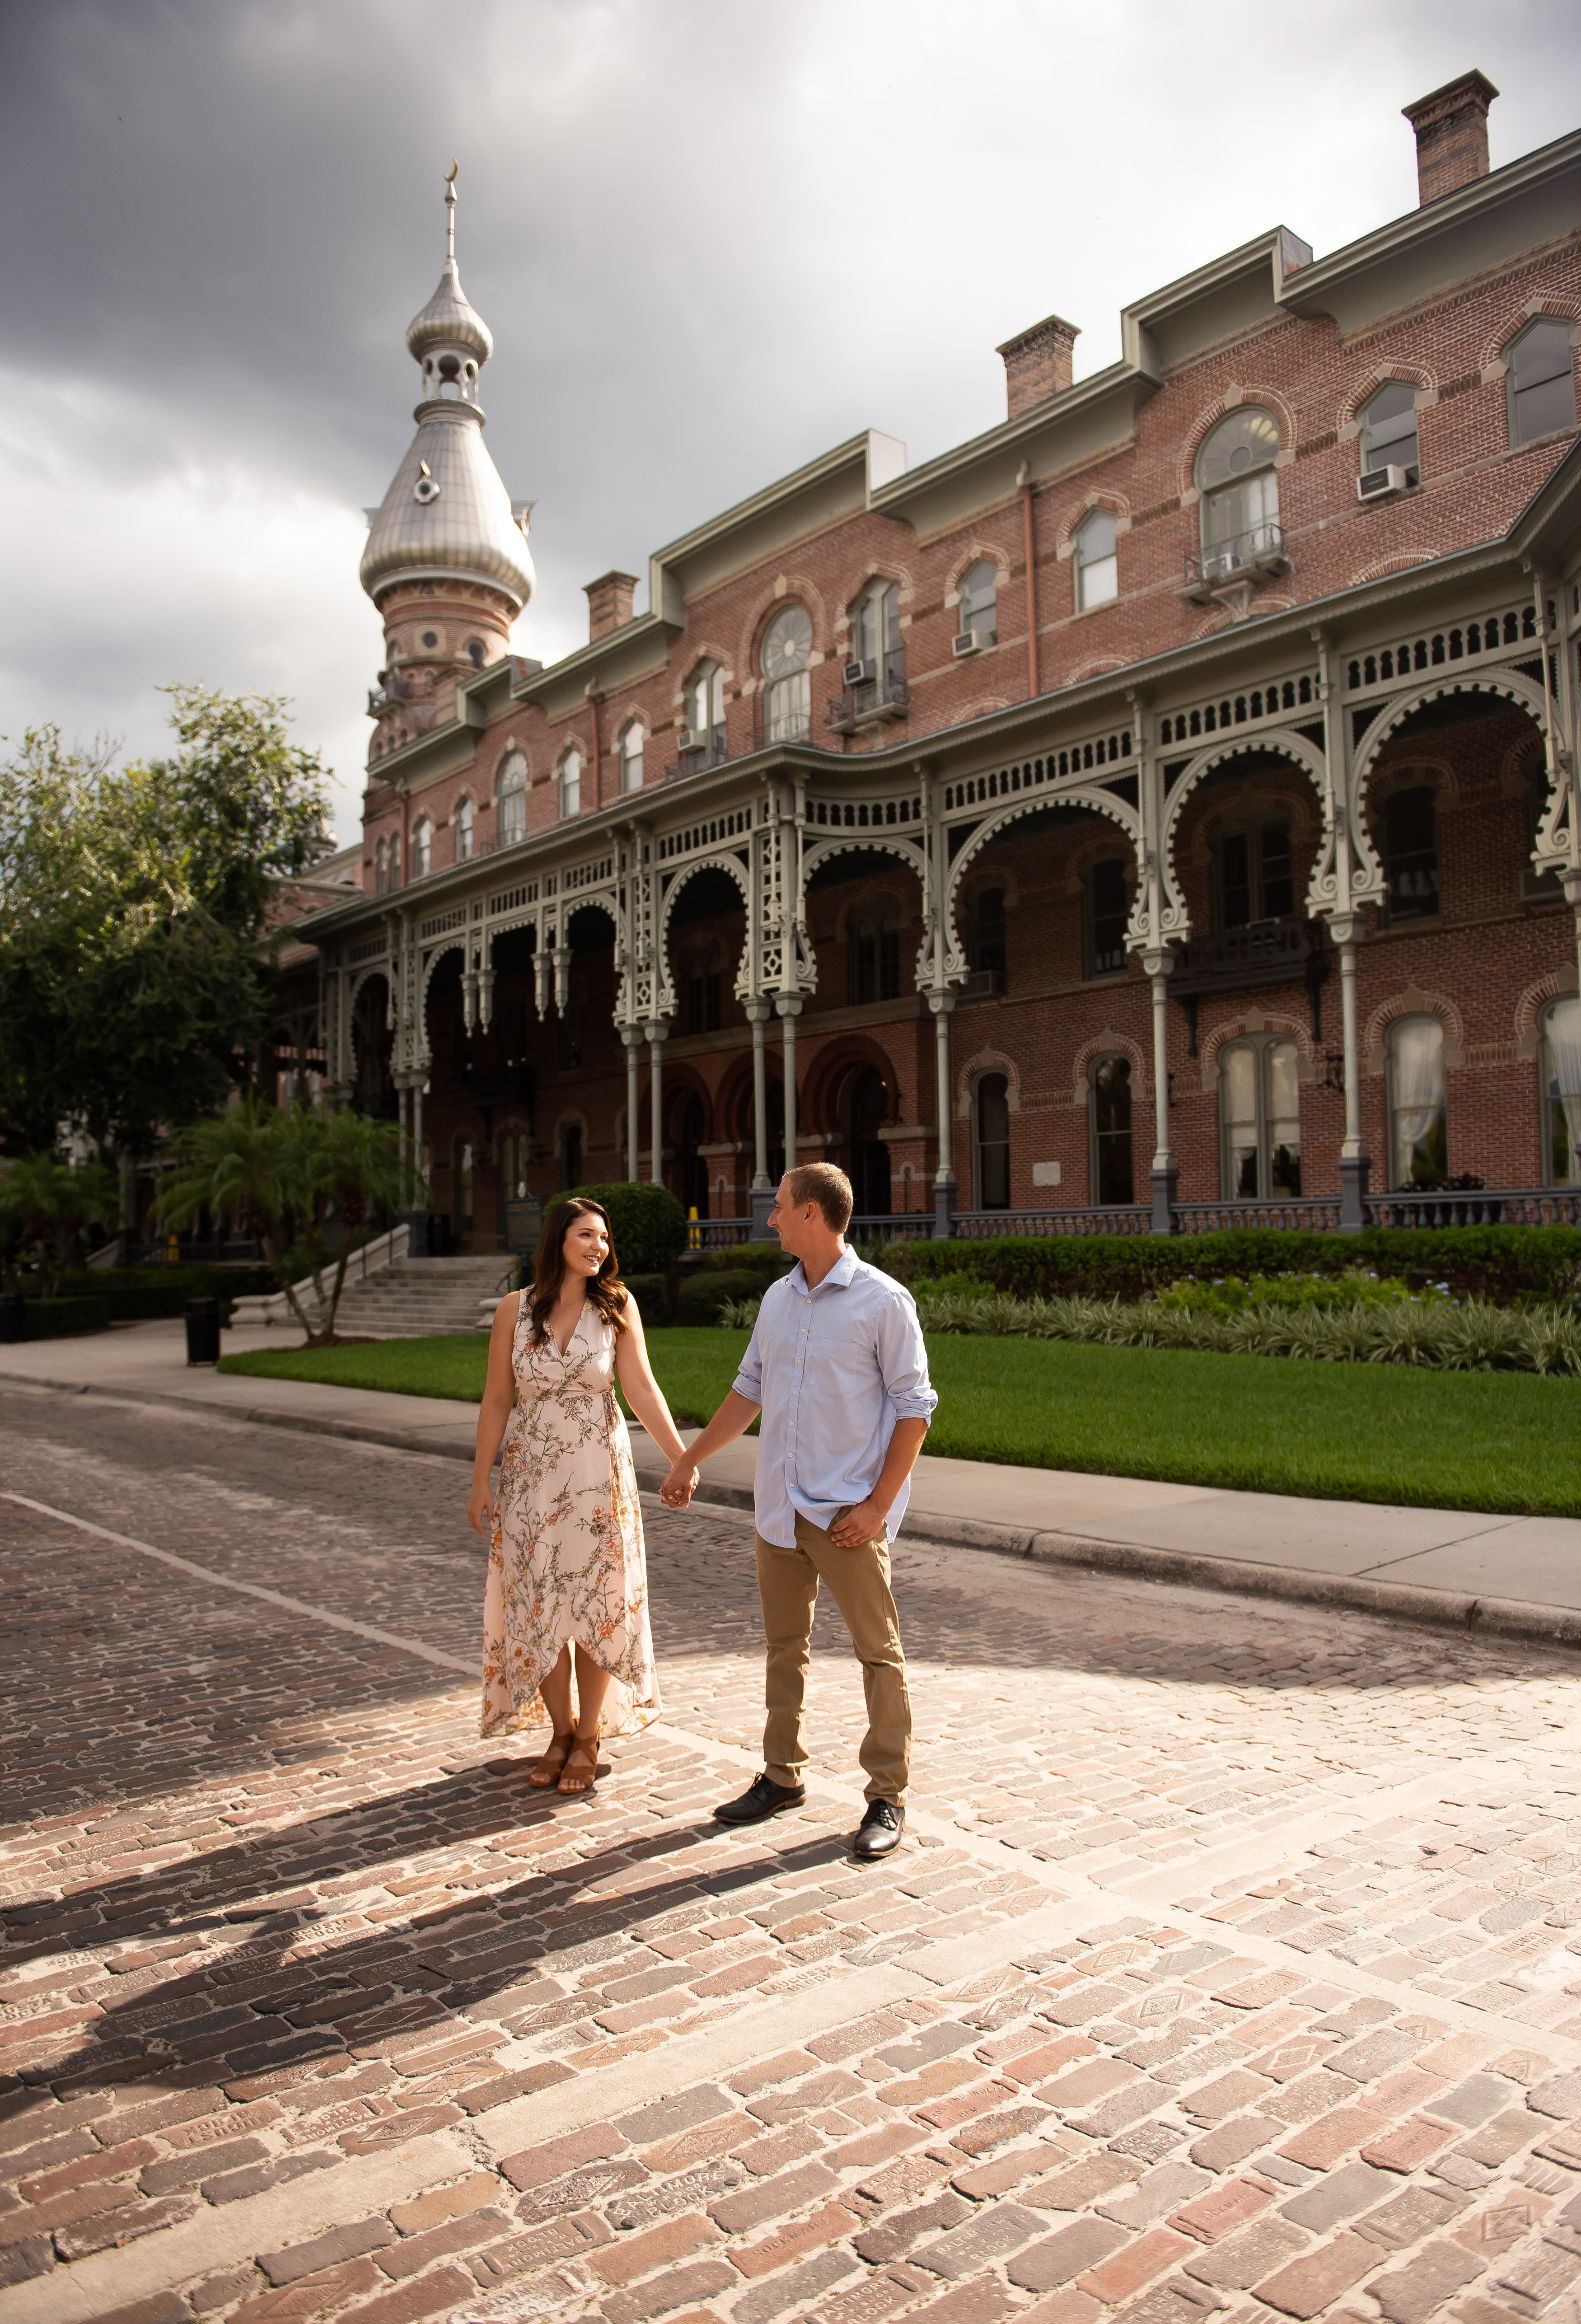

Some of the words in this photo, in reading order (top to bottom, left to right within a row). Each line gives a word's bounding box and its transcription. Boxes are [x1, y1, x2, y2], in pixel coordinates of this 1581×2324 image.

[276, 1916, 353, 1941] AUGUSTA
[293, 1923, 349, 1944] BLOCK
[473, 1930, 529, 1952] BALTIMORE
[1498, 1926, 1551, 1954] AUGUSTA
[804, 1938, 857, 1959] BALTIMORE
[1518, 1933, 1559, 1955] BLOCK
[228, 1950, 295, 1971] BALTIMORE
[370, 1952, 430, 1973] BALTIMORE
[766, 1961, 837, 1992] AUGUSTA
[786, 1969, 837, 1993] BLOCK
[821, 2019, 879, 2045] BALTIMORE
[846, 2030, 885, 2051] BLOCK
[1002, 2033, 1039, 2053] BLOCK
[181, 2107, 255, 2138] BLOCK
[298, 2111, 374, 2142] BALTIMORE
[861, 2152, 927, 2191] BALTIMORE
[892, 2168, 936, 2196] BLOCK
[616, 2170, 725, 2218] BALTIMORE
[646, 2183, 715, 2219] BLOCK
[1371, 2189, 1429, 2228] BALTIMORE
[1404, 2204, 1445, 2234] BLOCK
[503, 2227, 559, 2253] BLOCK
[753, 2215, 829, 2259] ROCKMART
[968, 2233, 1016, 2263] BLOCK
[498, 2234, 587, 2273] BALTIMORE
[811, 2273, 892, 2323] BALTIMORE
[844, 2293, 899, 2324] BLOCK
